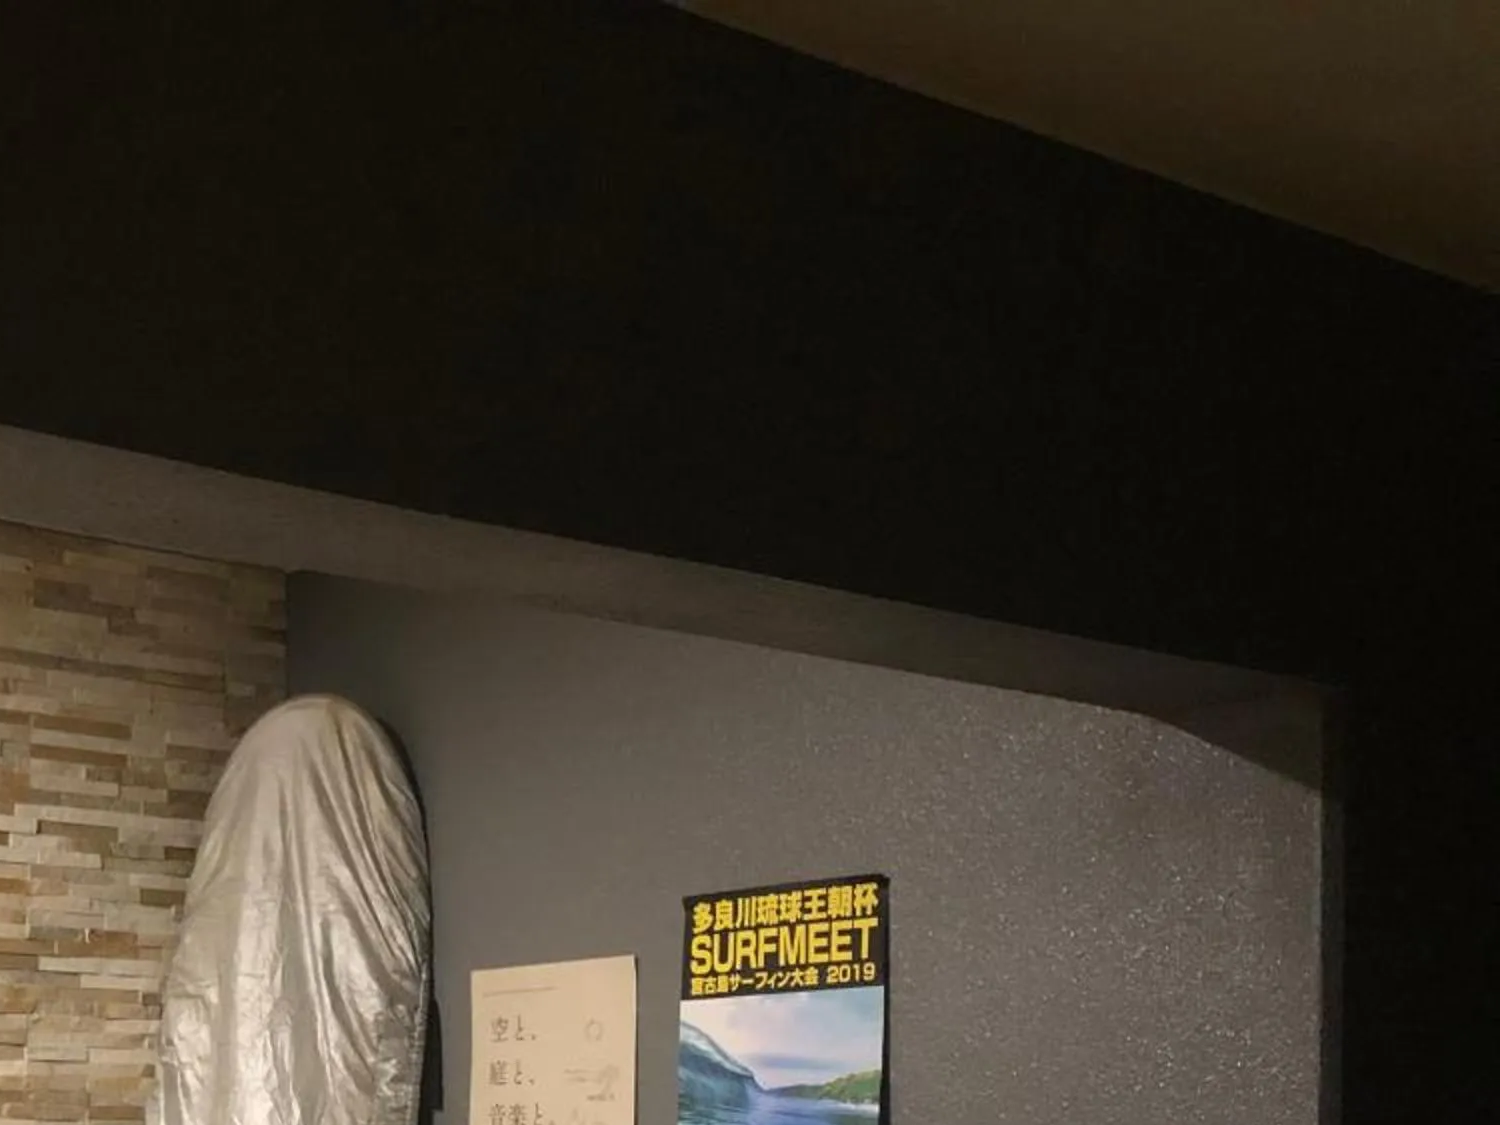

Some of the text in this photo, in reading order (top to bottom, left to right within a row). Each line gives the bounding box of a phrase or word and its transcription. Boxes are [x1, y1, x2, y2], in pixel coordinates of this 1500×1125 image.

[692, 882, 879, 934] 多良川琉球王朝杯
[690, 917, 879, 976] SURFMEET
[825, 961, 876, 984] 2019
